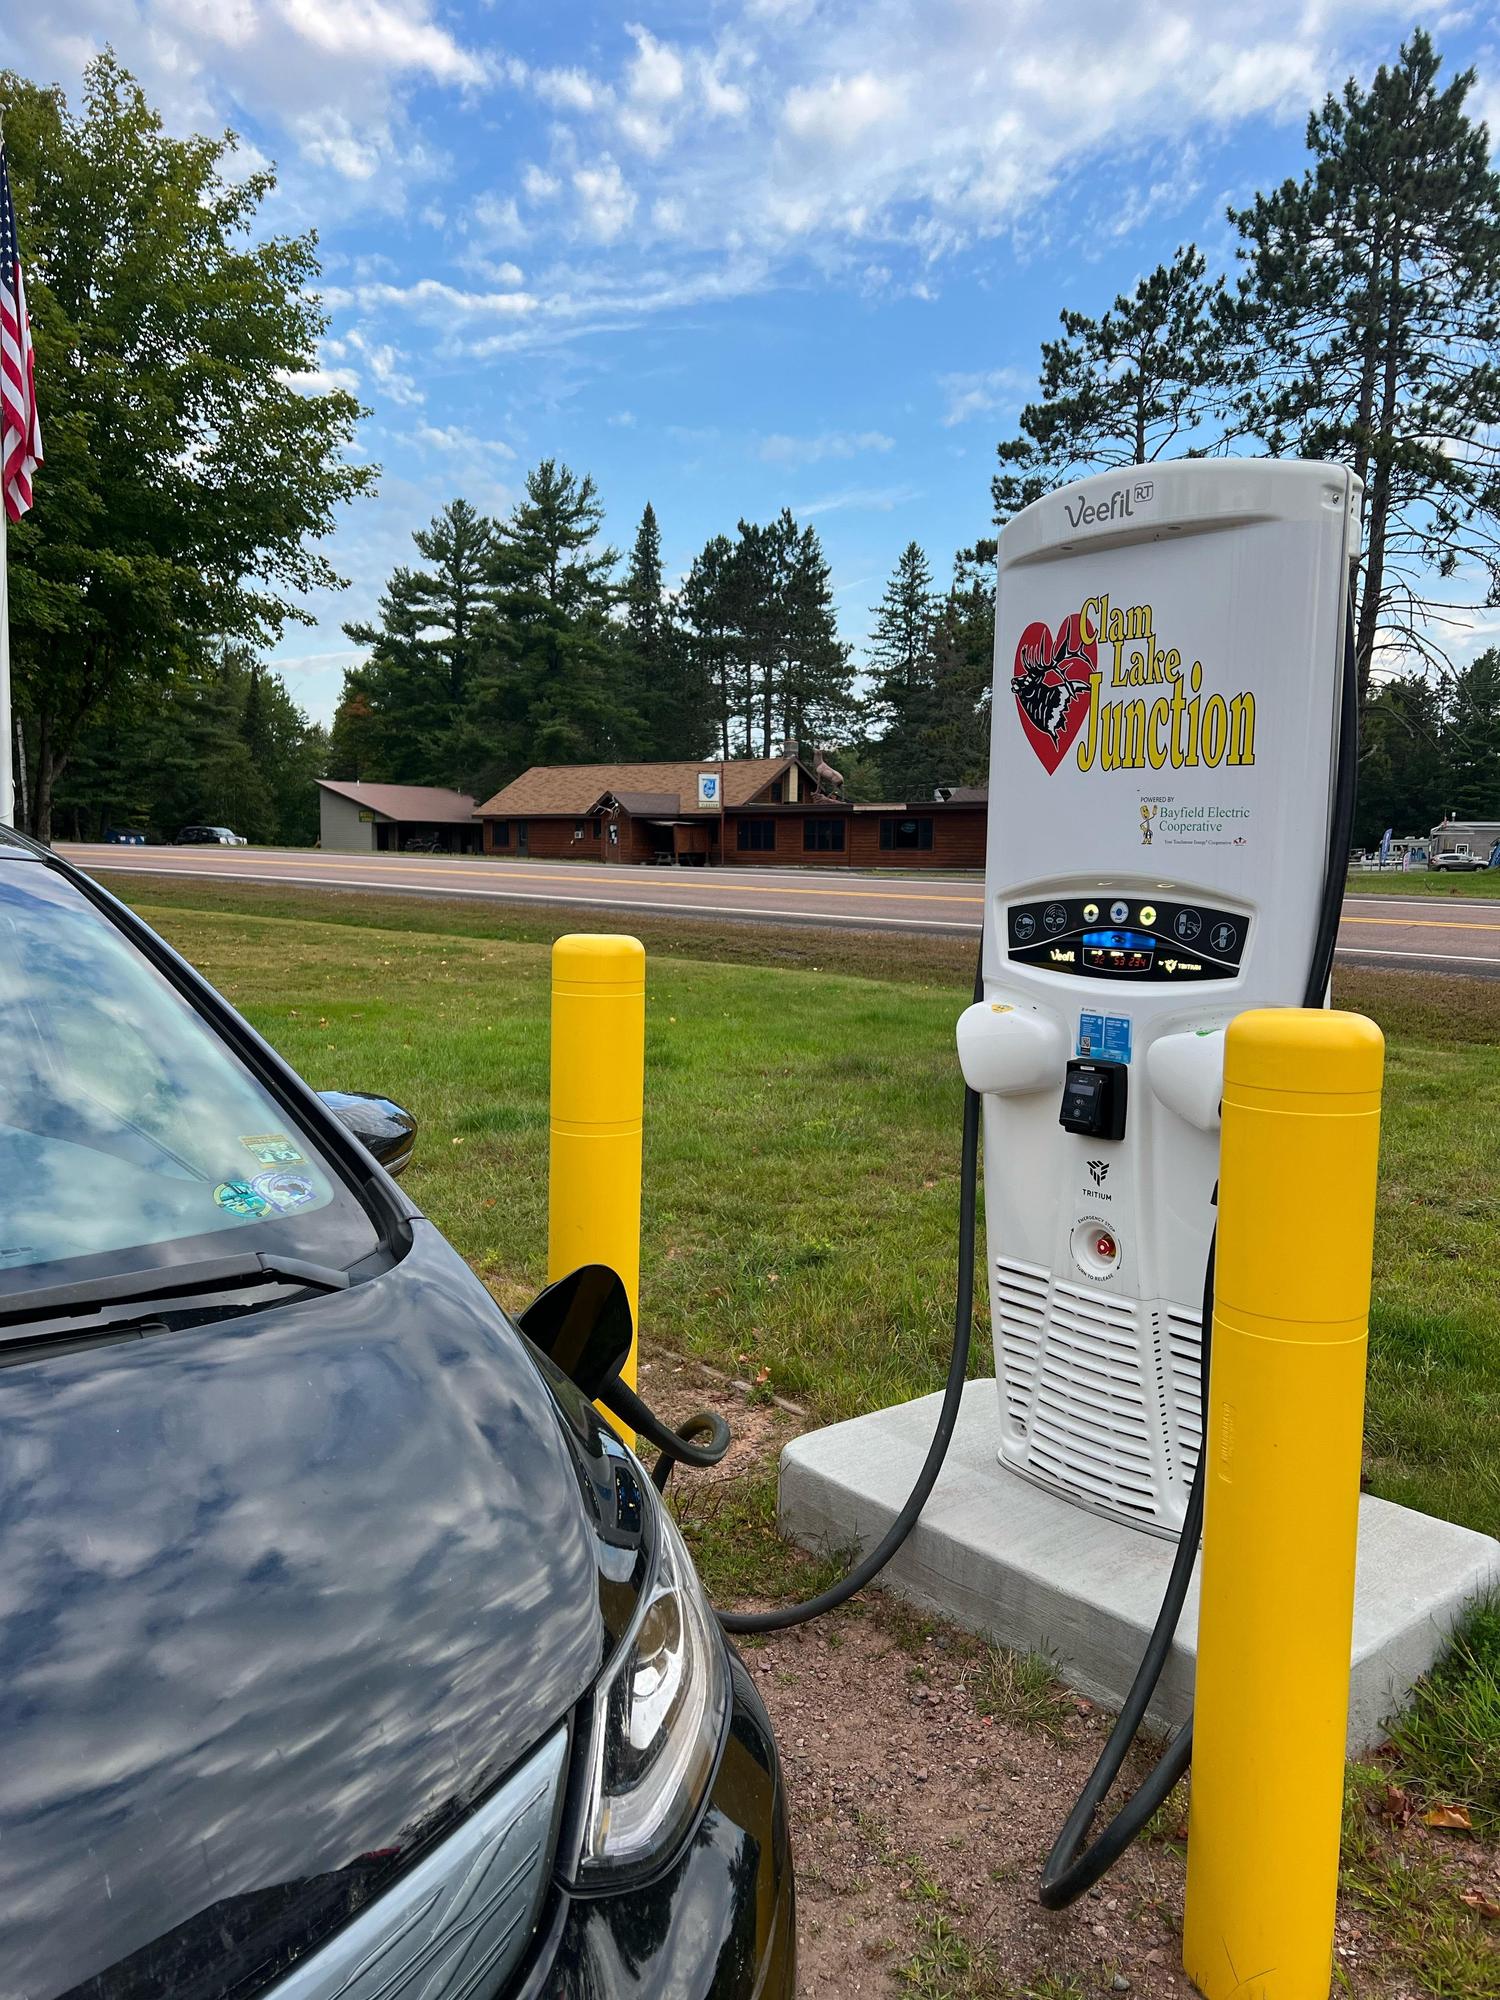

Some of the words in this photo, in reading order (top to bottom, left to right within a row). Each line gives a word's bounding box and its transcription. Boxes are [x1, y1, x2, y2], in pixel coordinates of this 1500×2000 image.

[1064, 489, 1134, 528] Veefil
[1135, 484, 1153, 500] RT
[1079, 593, 1153, 645] Clam
[1111, 634, 1181, 689] Lake
[1077, 660, 1257, 772] Junction
[1160, 806, 1204, 820] Bayfield
[1208, 806, 1250, 818] Electric
[1159, 820, 1223, 834] Cooperative
[1094, 955, 1105, 964] 32
[1114, 957, 1125, 966] 53
[1128, 957, 1146, 967] 234
[1082, 1188, 1112, 1202] TRITIUM
[1077, 1215, 1105, 1224] EMERGENCY
[1104, 1221, 1116, 1233] STOP
[1076, 1263, 1087, 1276] TURN
[1094, 1273, 1114, 1282] RELEASE
